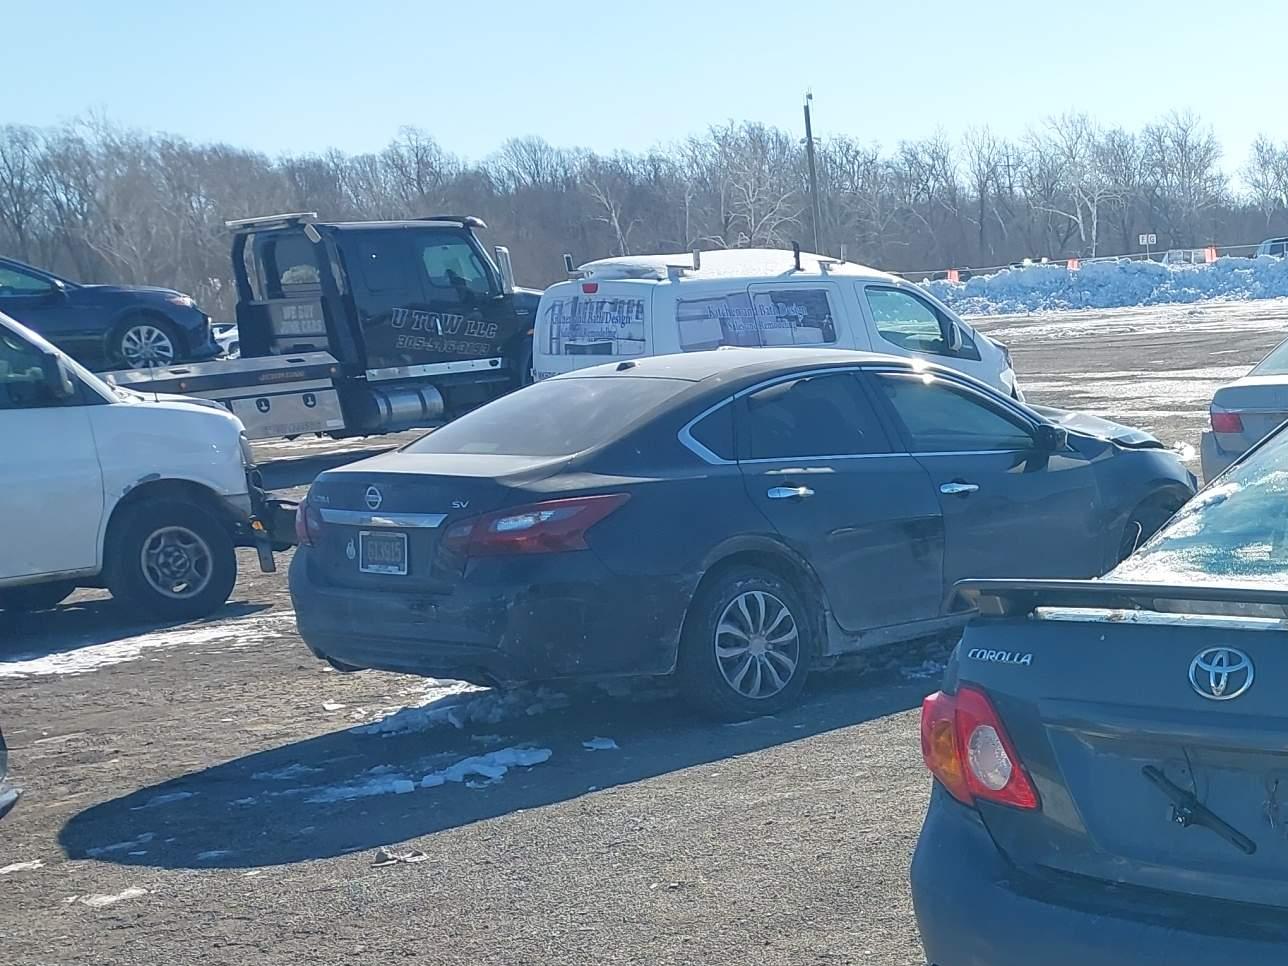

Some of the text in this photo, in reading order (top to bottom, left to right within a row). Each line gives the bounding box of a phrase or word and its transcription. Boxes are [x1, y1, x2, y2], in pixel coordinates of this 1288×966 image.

[391, 307, 498, 339] U TOW LLC
[604, 312, 632, 328] Design
[450, 500, 470, 509] SV
[968, 648, 1033, 666] COROLLA
